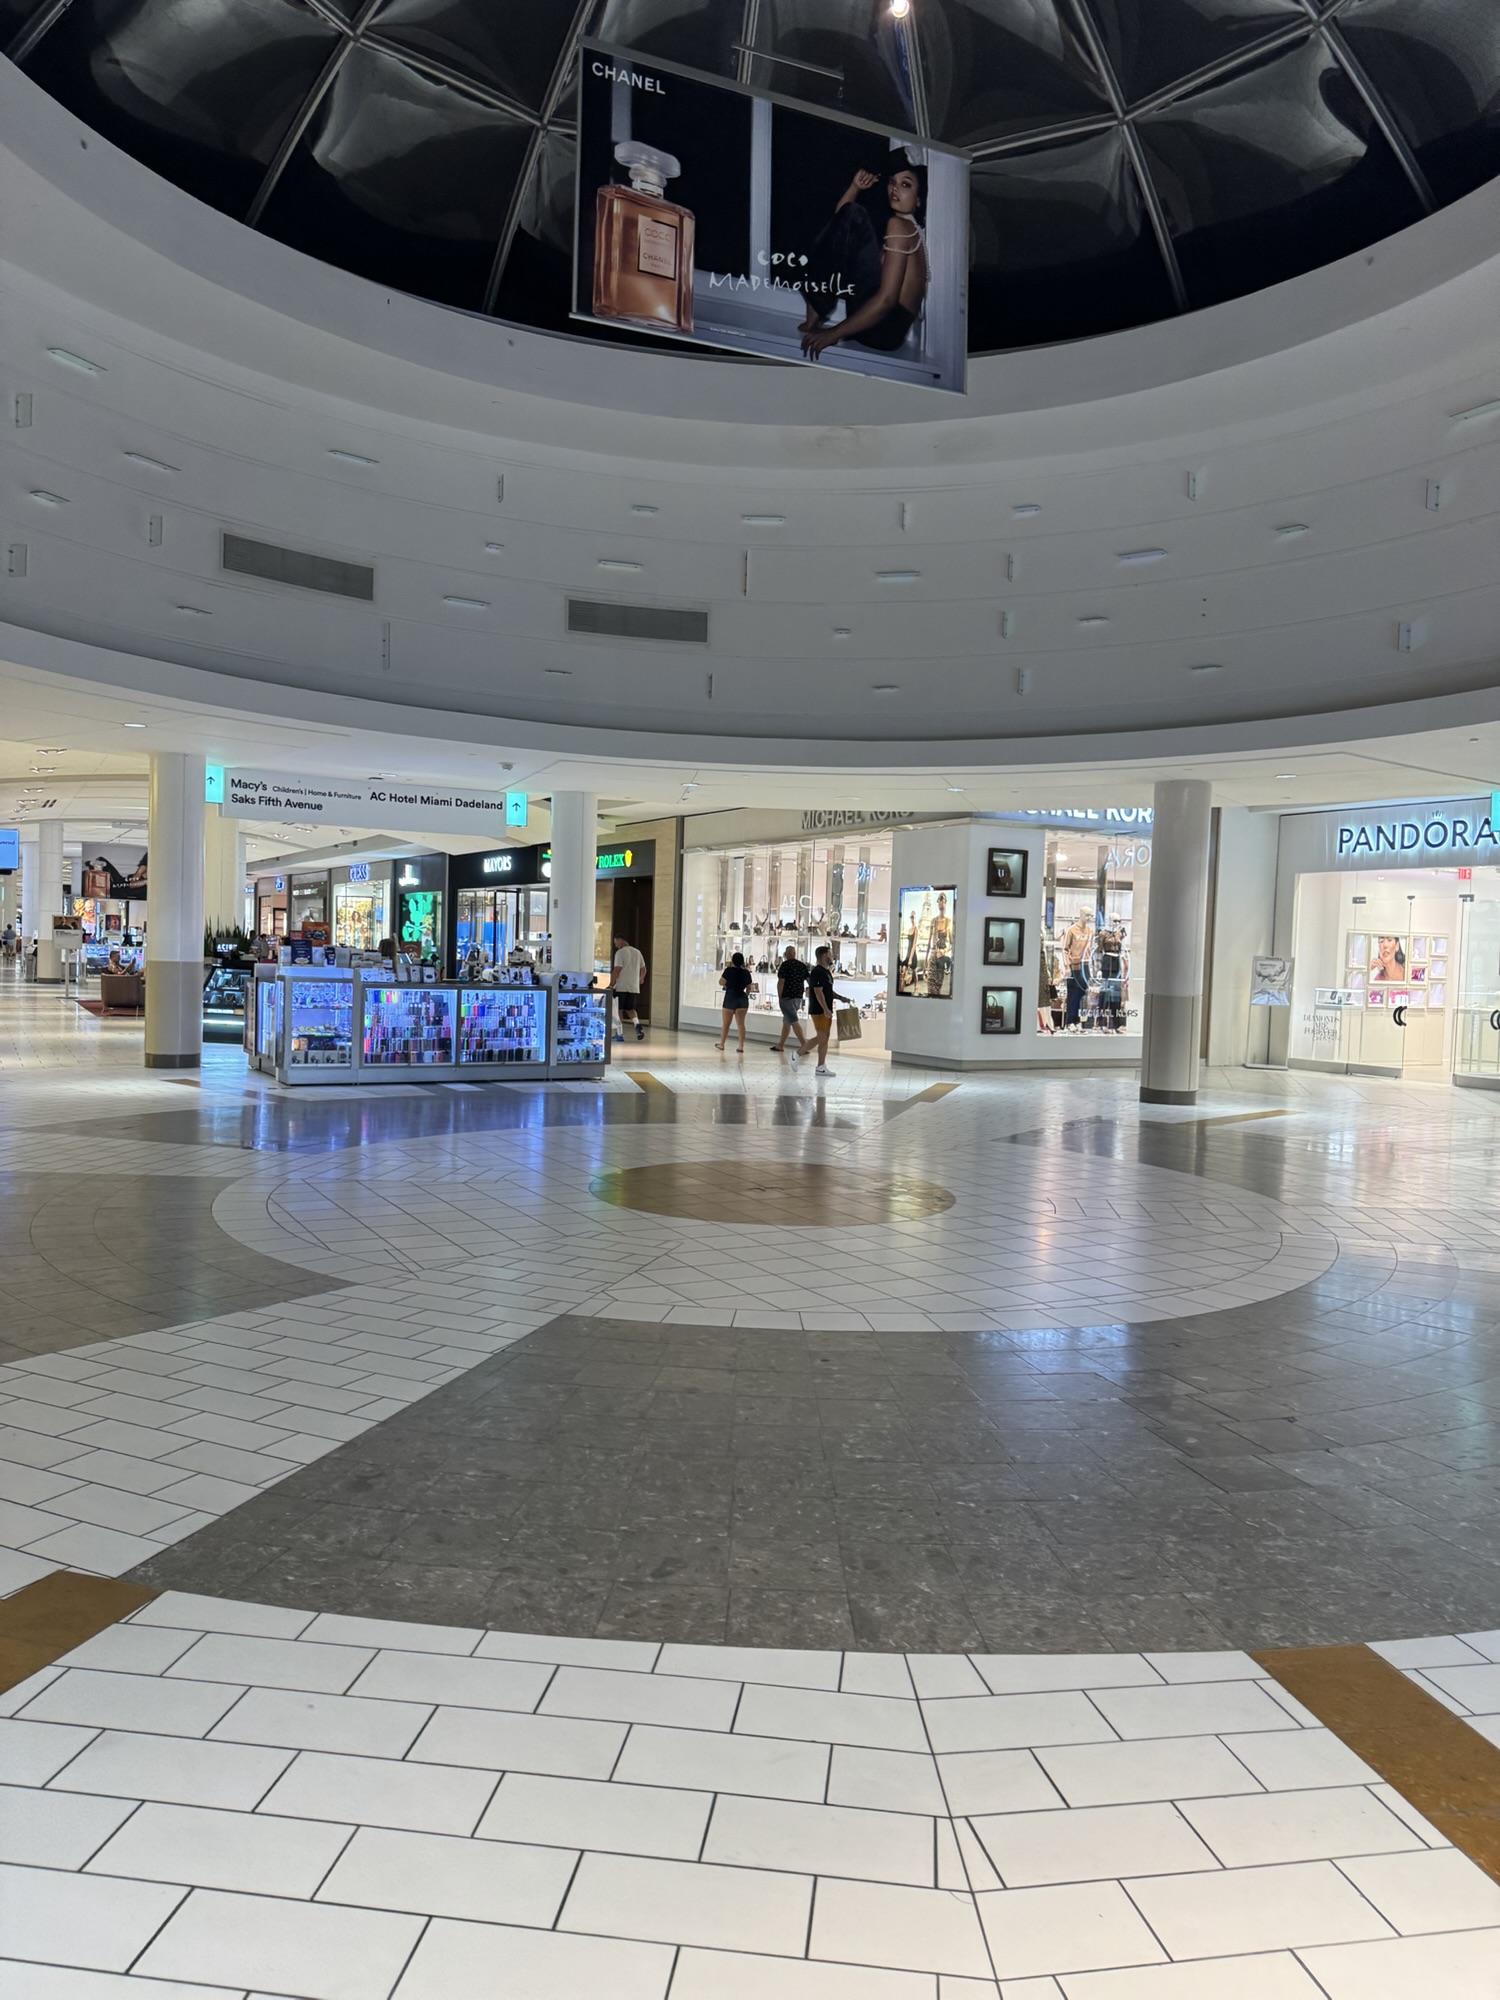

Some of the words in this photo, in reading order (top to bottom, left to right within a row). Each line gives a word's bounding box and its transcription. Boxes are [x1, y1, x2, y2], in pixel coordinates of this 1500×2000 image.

[592, 62, 666, 95] CHANEL
[230, 778, 267, 792] Macy's
[272, 785, 304, 795] Children's
[308, 789, 327, 798] Home
[327, 790, 333, 798] &
[334, 791, 362, 800] Furniture
[231, 793, 256, 806] Saks
[259, 796, 282, 808] Fifth
[284, 799, 323, 811] Avenue
[370, 791, 387, 802] AC
[389, 793, 418, 804] Hotel
[420, 795, 453, 807] Miami
[455, 798, 503, 810] Dadeland
[1338, 816, 1499, 853] PANDORA
[598, 854, 625, 868] ROLEX
